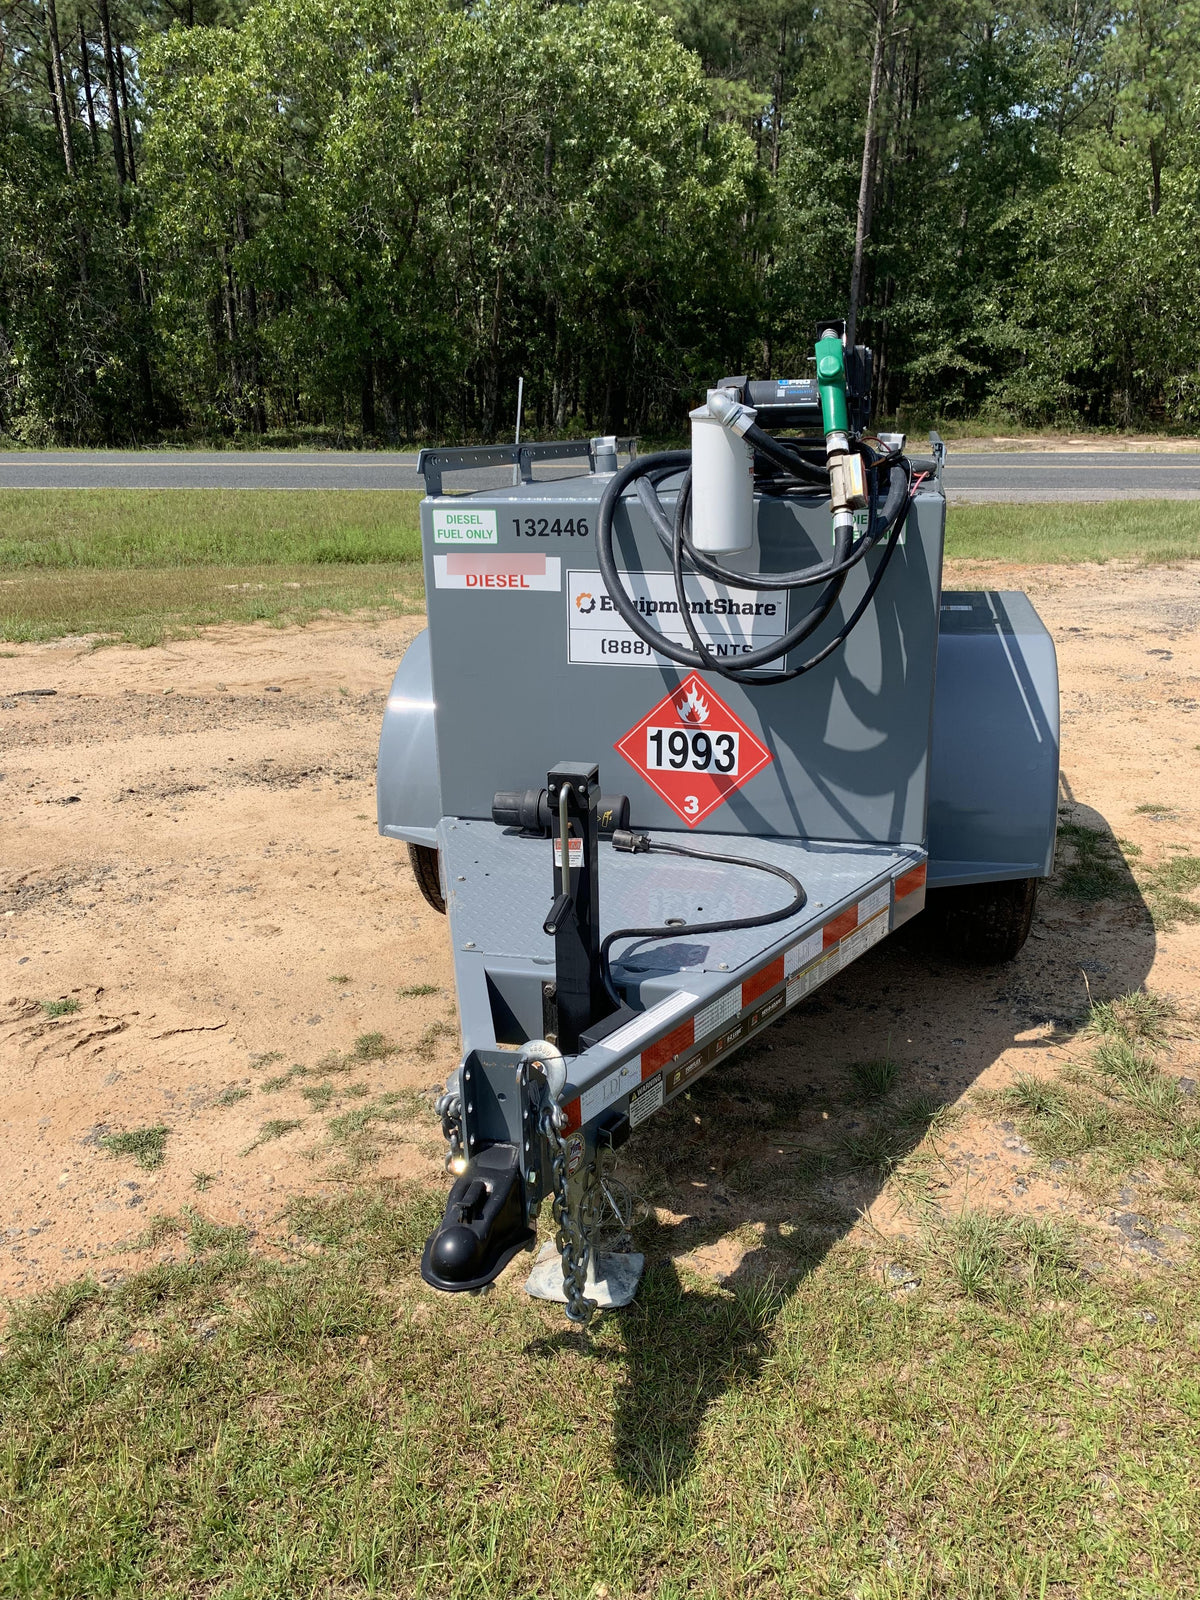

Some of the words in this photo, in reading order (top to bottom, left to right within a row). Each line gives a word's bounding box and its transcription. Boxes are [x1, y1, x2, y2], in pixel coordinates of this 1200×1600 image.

[446, 514, 483, 525] DIESEL
[512, 518, 589, 537] 132446
[437, 529, 463, 539] FUEL
[466, 529, 493, 539] ONLY
[465, 574, 530, 588] DIESEL
[601, 638, 651, 656] (888)
[649, 729, 735, 773] 1993
[684, 795, 699, 814] 3
